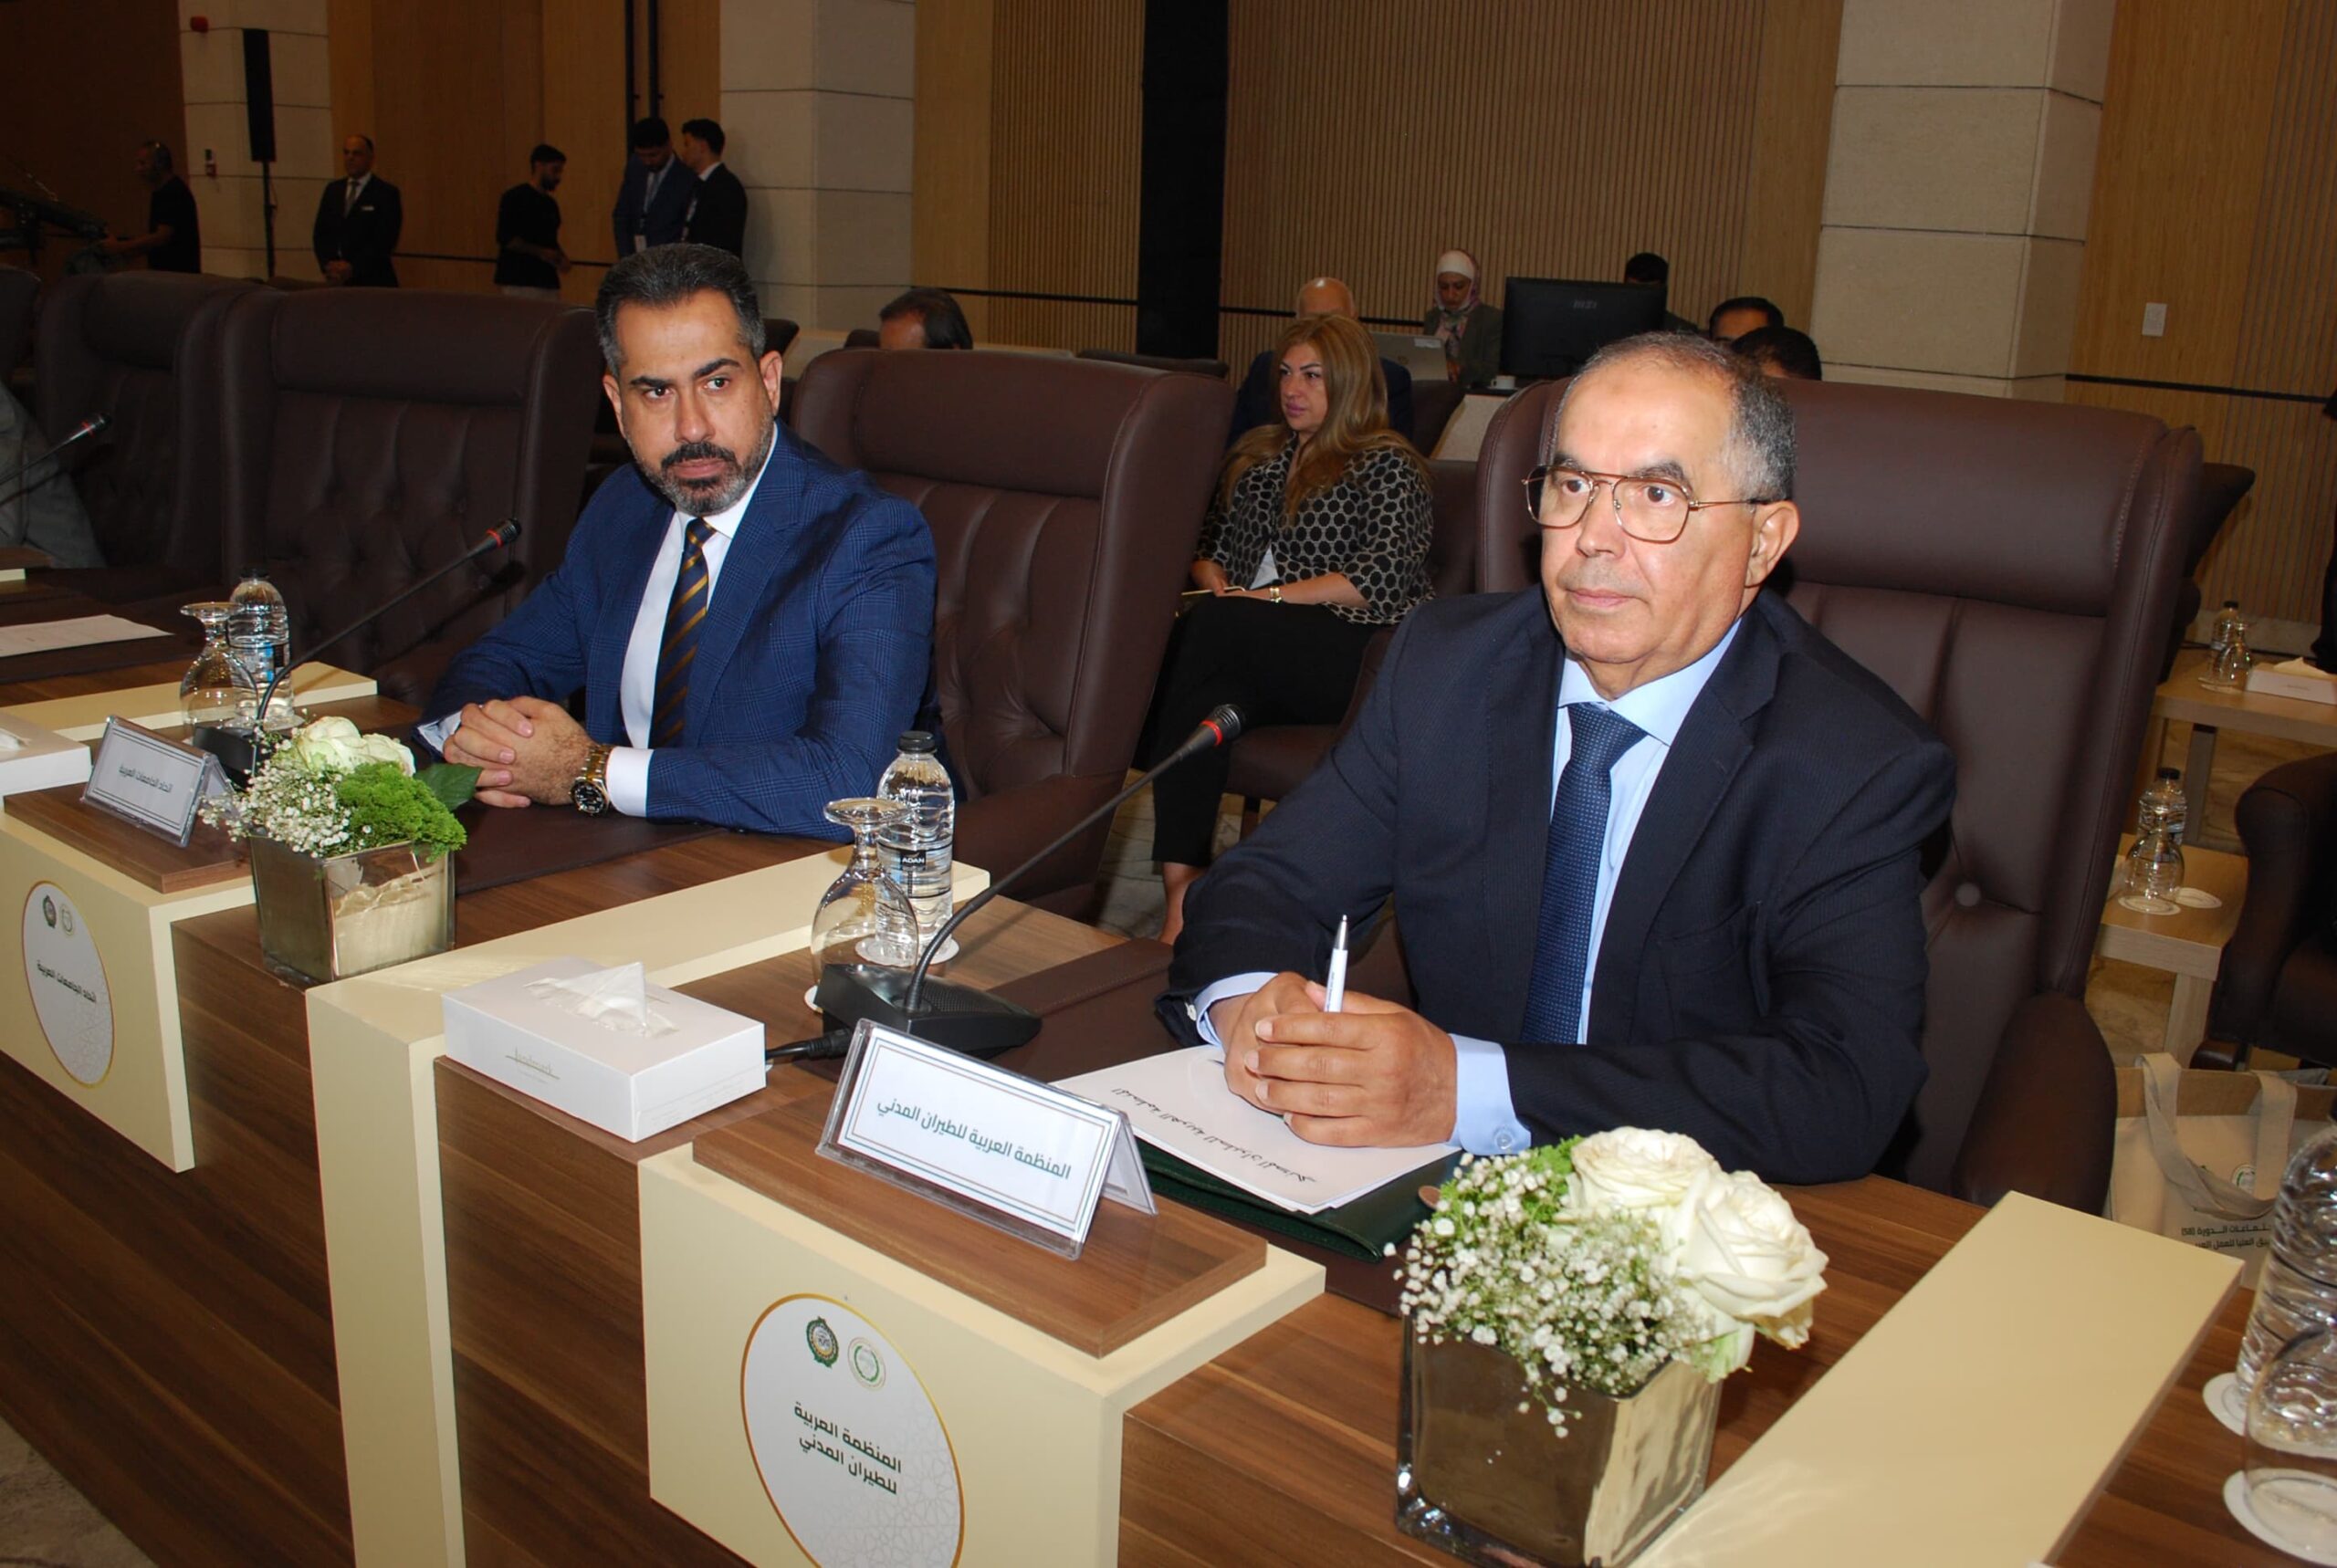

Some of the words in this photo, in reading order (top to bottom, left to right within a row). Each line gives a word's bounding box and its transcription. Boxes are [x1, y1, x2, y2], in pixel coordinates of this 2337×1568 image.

[876, 1098, 921, 1123] المدني
[920, 1111, 968, 1140] للطيران
[1159, 1113, 1206, 1134] العربية
[968, 1128, 1012, 1156] العربية
[1014, 1146, 1072, 1180] المنظمة
[793, 1401, 839, 1438] العربية
[799, 1433, 844, 1465] المدني
[842, 1427, 902, 1474] المنظمة
[847, 1456, 897, 1496] للطيران
